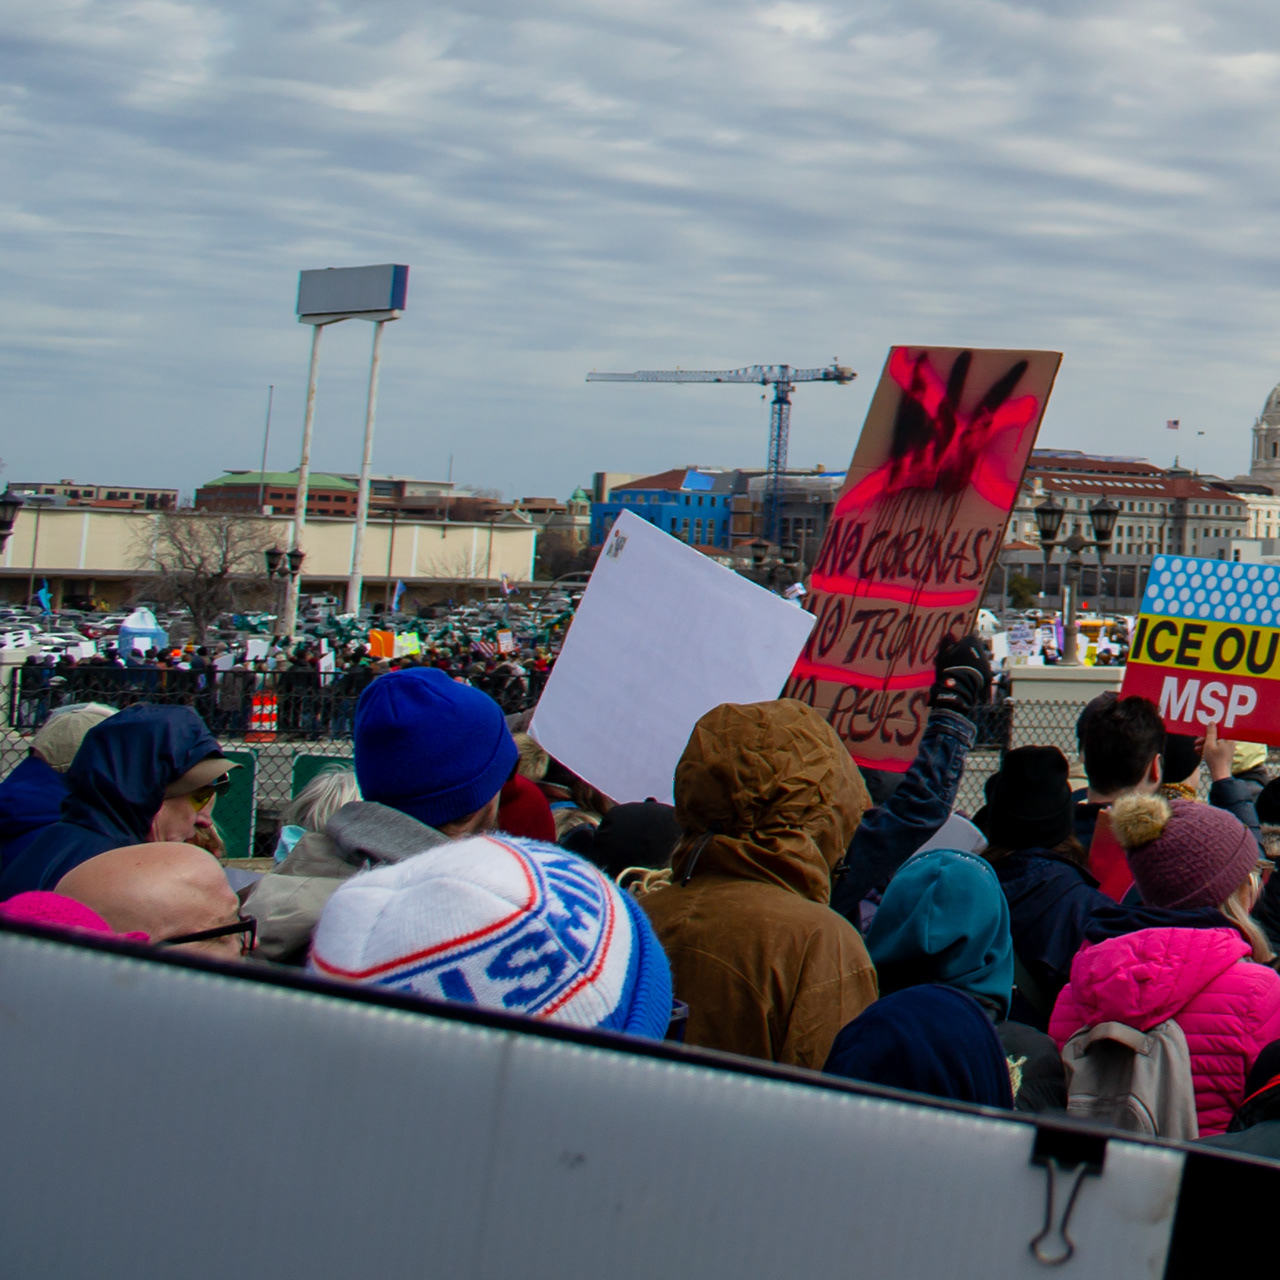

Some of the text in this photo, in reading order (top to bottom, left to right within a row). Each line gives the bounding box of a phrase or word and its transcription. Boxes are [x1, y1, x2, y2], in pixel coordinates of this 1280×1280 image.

[818, 517, 867, 578] NO
[1131, 618, 1208, 668] ICE
[827, 685, 930, 747] REYES
[1160, 676, 1258, 729] MSP
